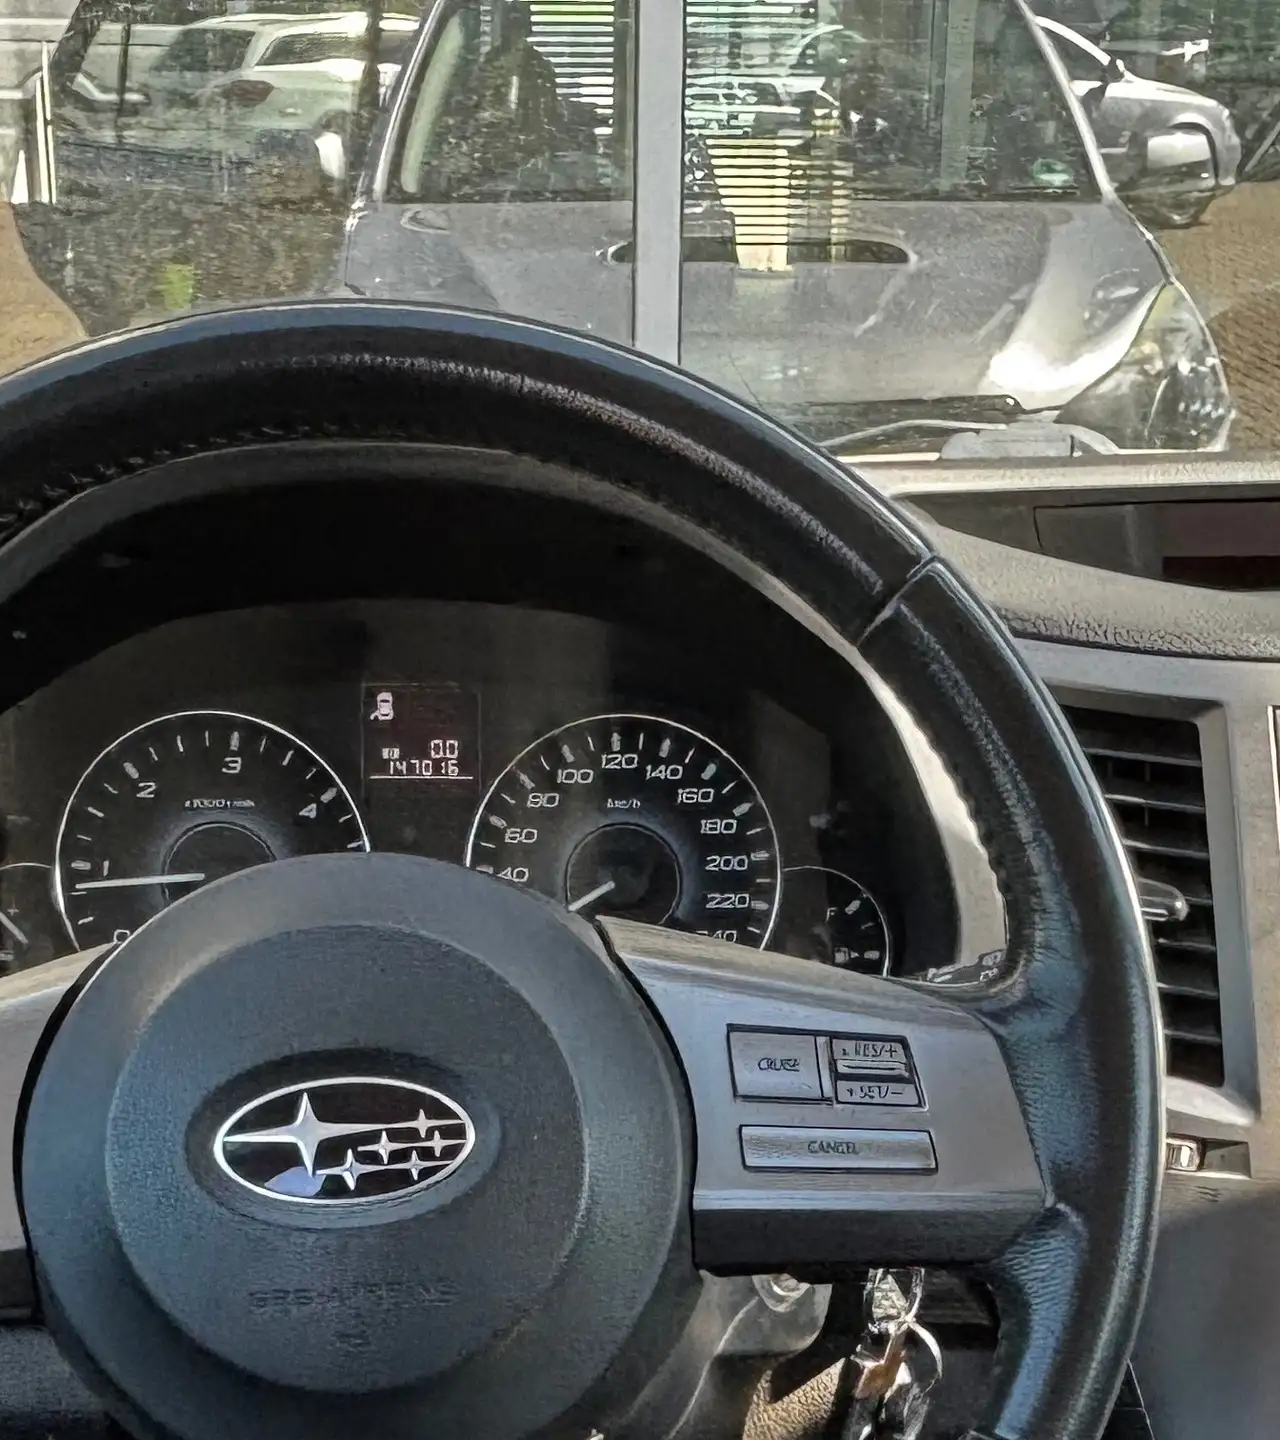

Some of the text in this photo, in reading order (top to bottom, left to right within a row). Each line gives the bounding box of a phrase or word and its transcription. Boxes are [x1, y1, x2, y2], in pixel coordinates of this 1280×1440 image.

[221, 756, 242, 774] 3
[601, 753, 639, 770] 120
[556, 767, 595, 785] 100
[645, 764, 684, 781] 140
[135, 781, 157, 799] 2
[676, 787, 715, 804] 160
[526, 792, 560, 809] 80
[298, 803, 318, 820] 4
[699, 818, 738, 835] 180
[504, 827, 538, 844] 60
[704, 854, 749, 872] 200
[496, 866, 530, 883] 40
[705, 893, 751, 909] 220
